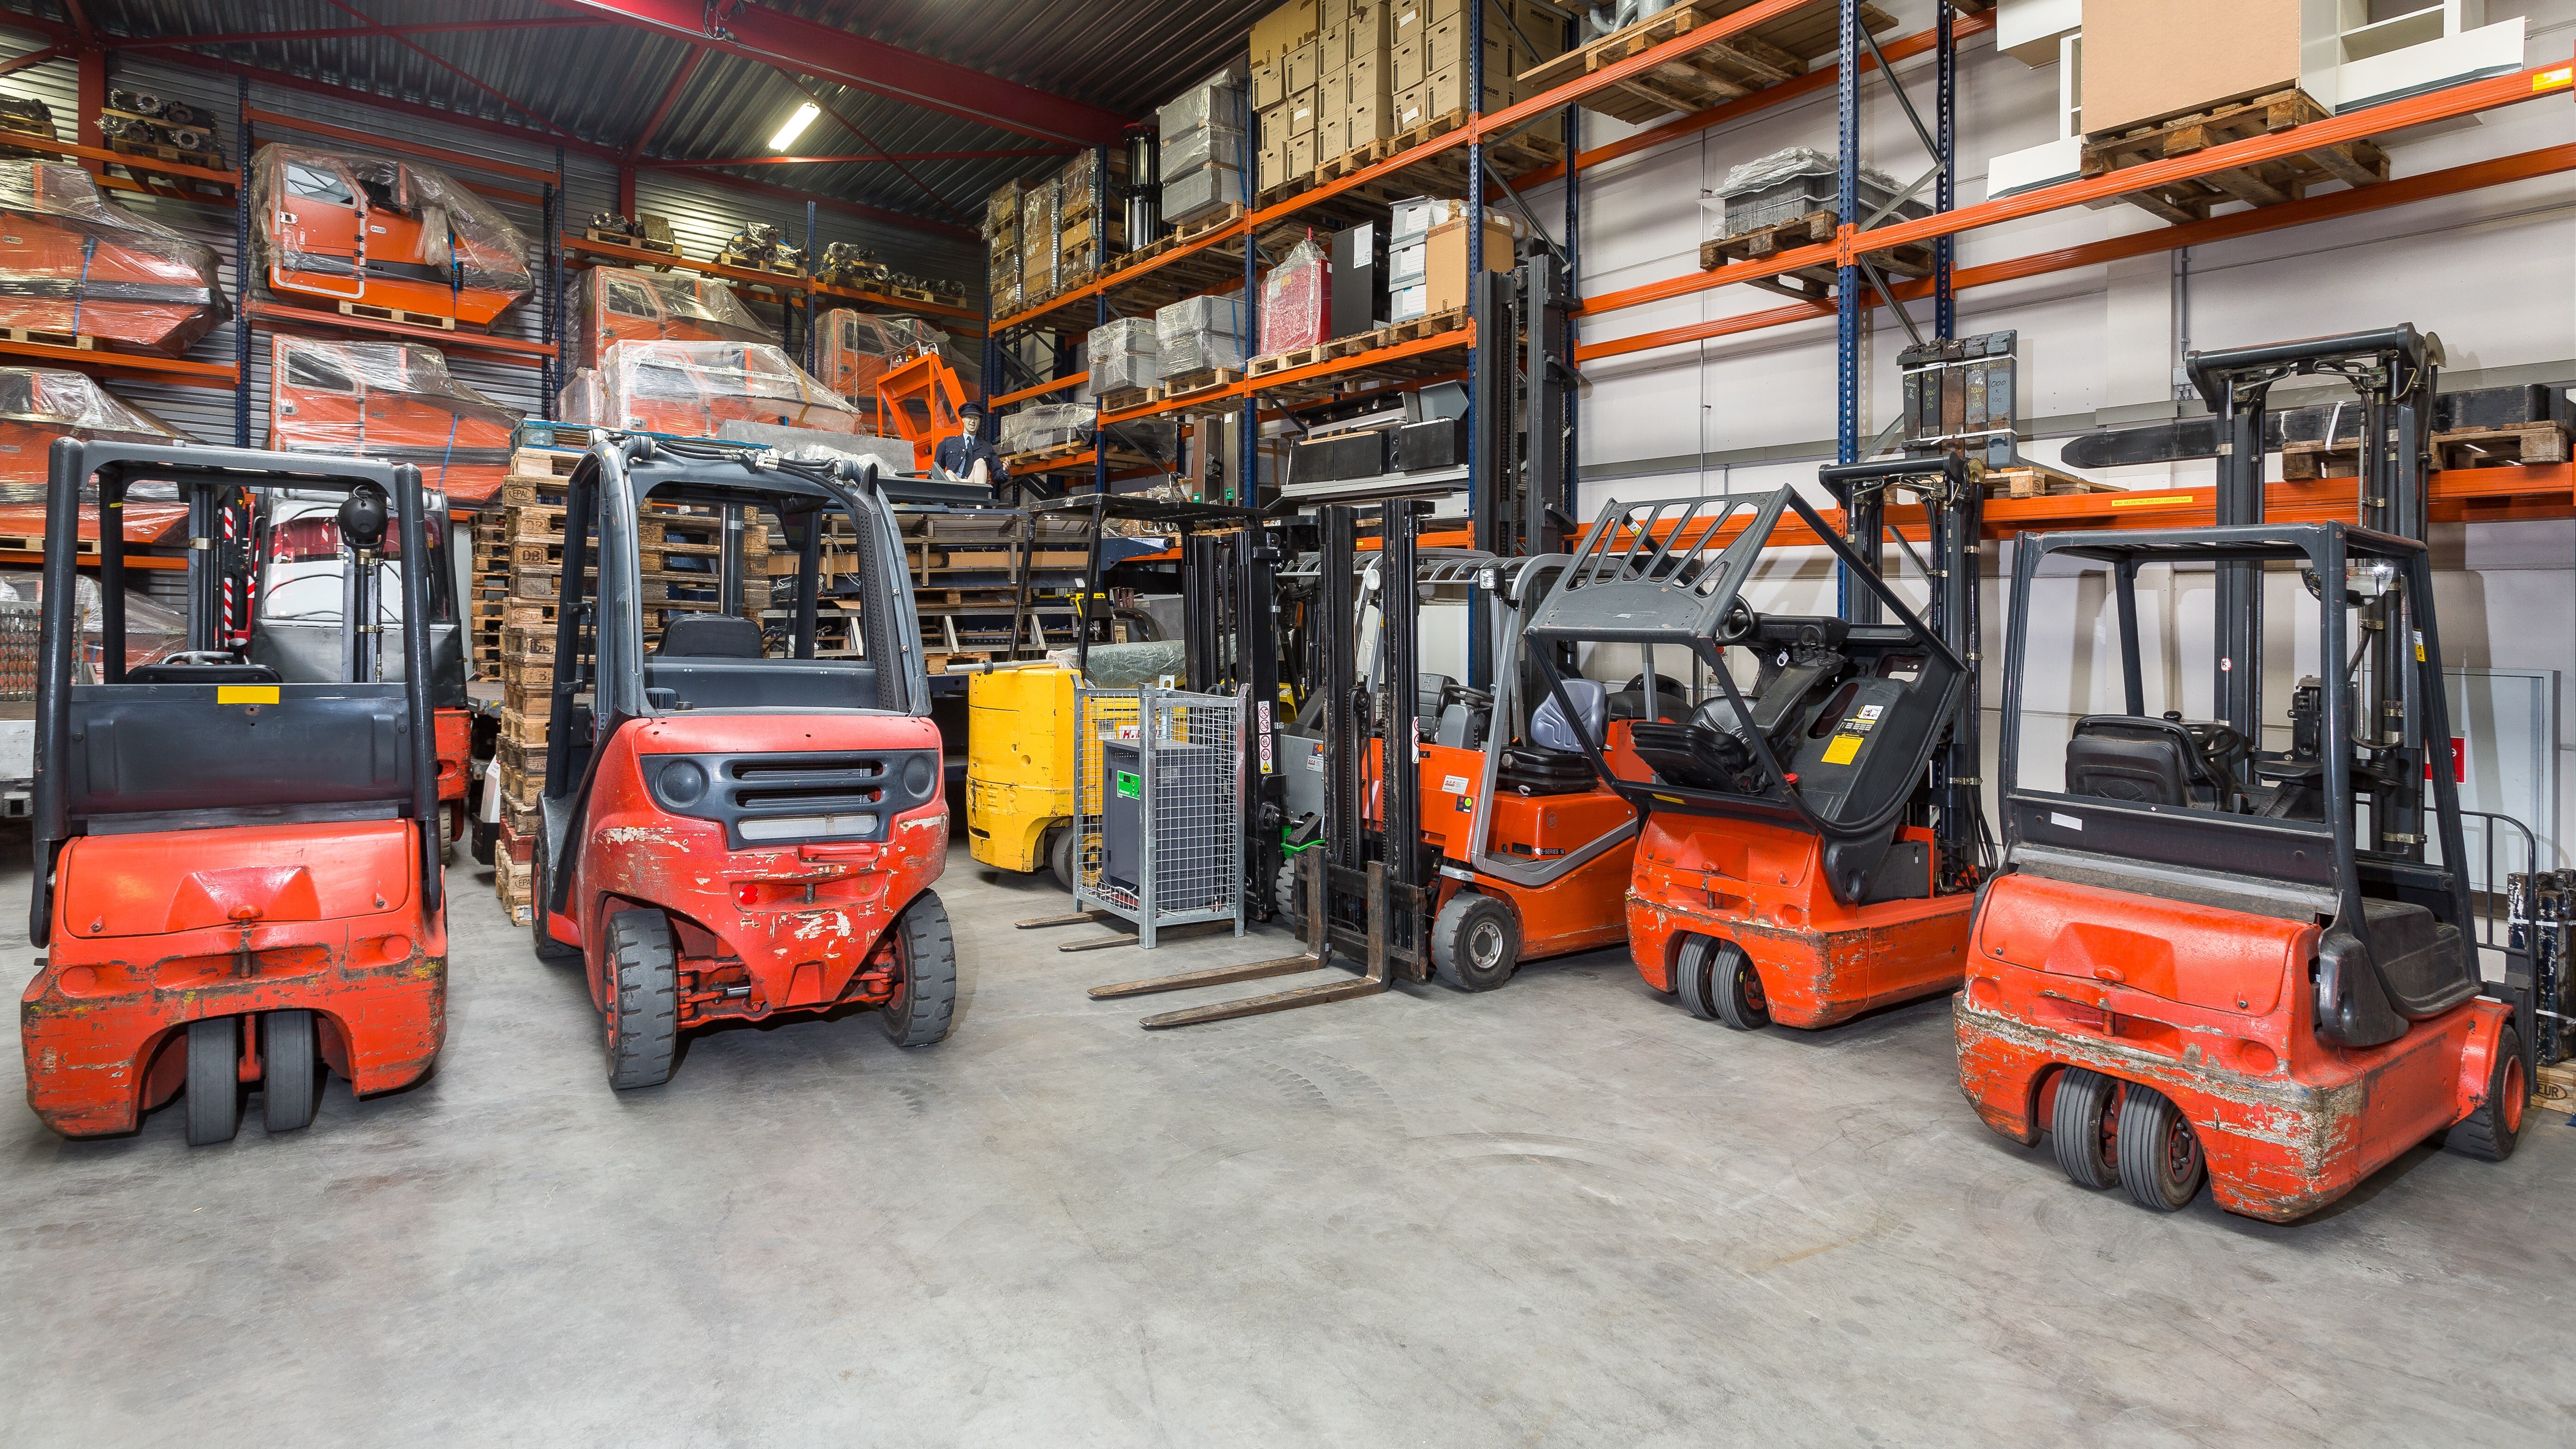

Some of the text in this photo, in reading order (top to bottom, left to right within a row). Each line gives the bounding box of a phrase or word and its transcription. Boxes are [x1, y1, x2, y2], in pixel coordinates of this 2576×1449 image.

[1530, 9, 1553, 23] SHURGARD
[1484, 37, 1498, 48] RGARD
[1484, 85, 1499, 96] RGARD
[1989, 380, 2006, 389] 1000
[513, 490, 529, 498] EPAL
[523, 550, 540, 561] DB
[2537, 1083, 2559, 1098] EUR
